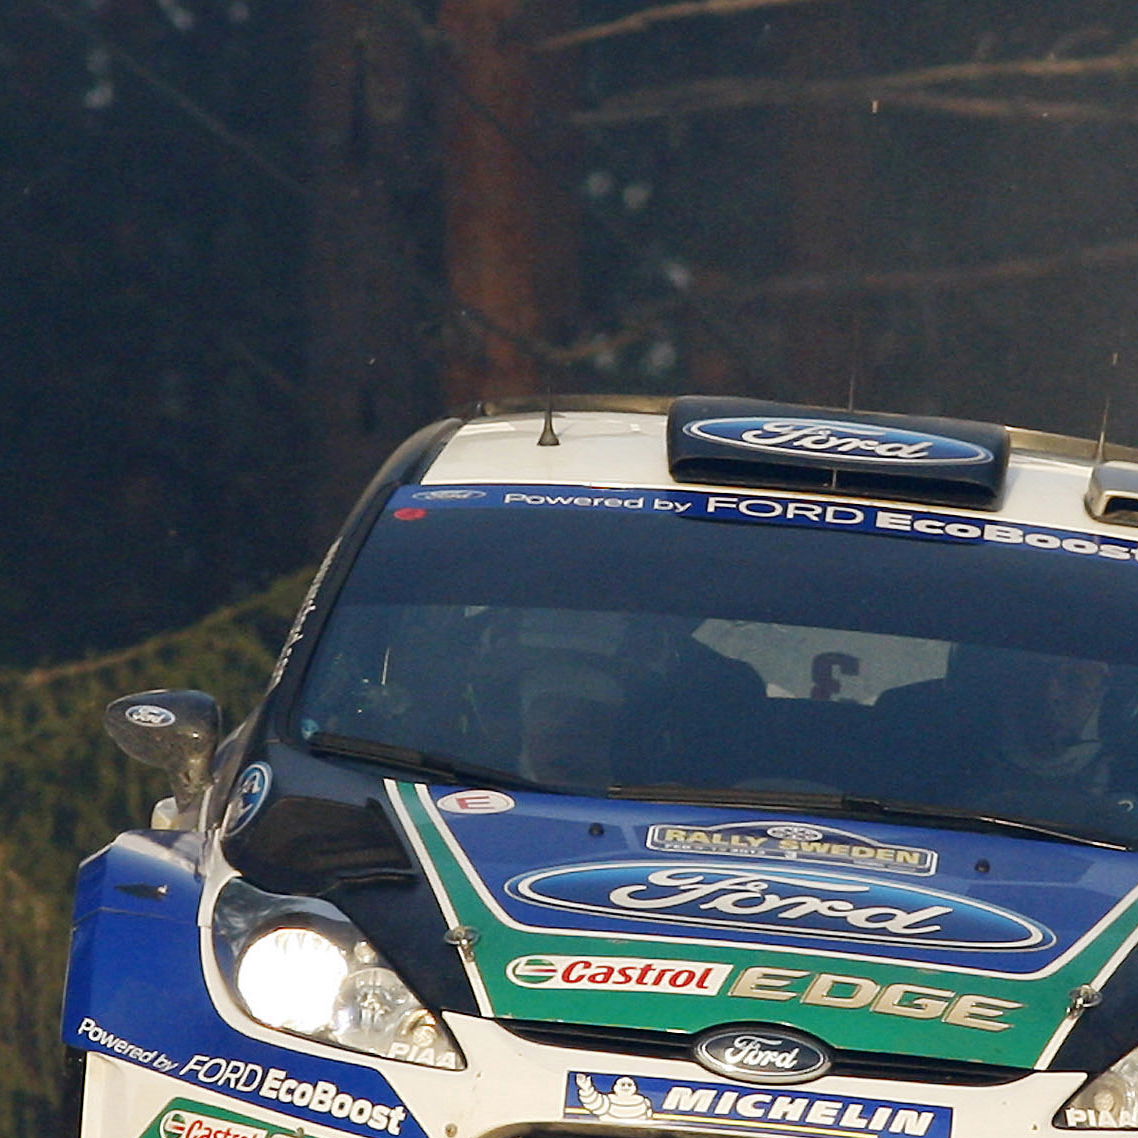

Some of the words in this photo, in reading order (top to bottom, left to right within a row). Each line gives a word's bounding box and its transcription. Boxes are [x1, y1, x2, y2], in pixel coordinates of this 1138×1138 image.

[741, 420, 933, 459] Ford
[504, 493, 644, 510] Powered
[653, 497, 692, 513] by
[707, 497, 864, 525] FORD
[665, 829, 769, 847] RALLY
[778, 839, 922, 864] SWEDEN
[608, 867, 954, 935] Ford
[560, 959, 711, 991] Castrol
[728, 966, 1025, 1032] EDGE
[387, 1042, 457, 1068] PIAA
[724, 1035, 800, 1070] Ford
[77, 1017, 159, 1063] Powered
[150, 1050, 179, 1072] by
[180, 1055, 264, 1093] FORD
[258, 1070, 410, 1136] EcoBoost
[662, 1086, 935, 1137] MICHELIN
[1065, 1108, 1136, 1128] PIAA
